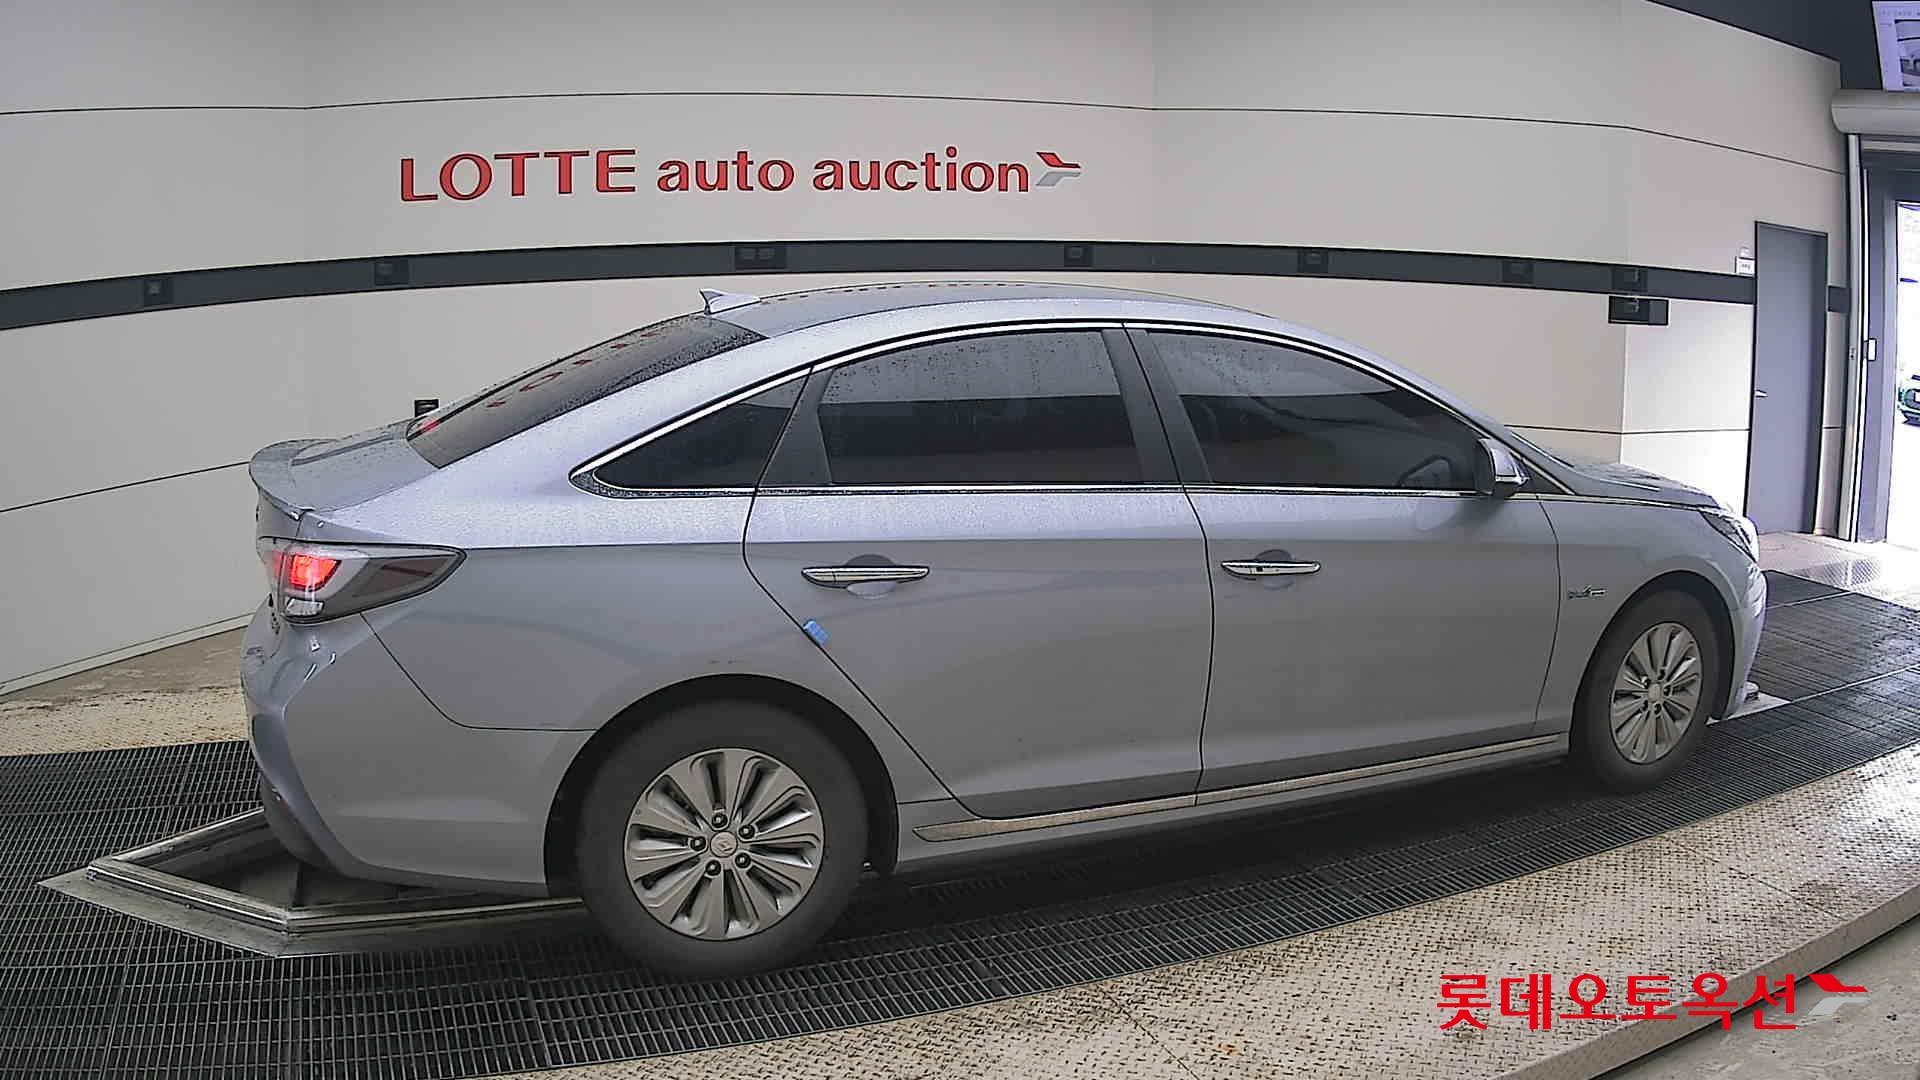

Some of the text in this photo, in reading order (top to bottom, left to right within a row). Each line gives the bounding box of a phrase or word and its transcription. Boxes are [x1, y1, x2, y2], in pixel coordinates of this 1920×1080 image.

[401, 146, 1031, 202] LOTTE auto auction
